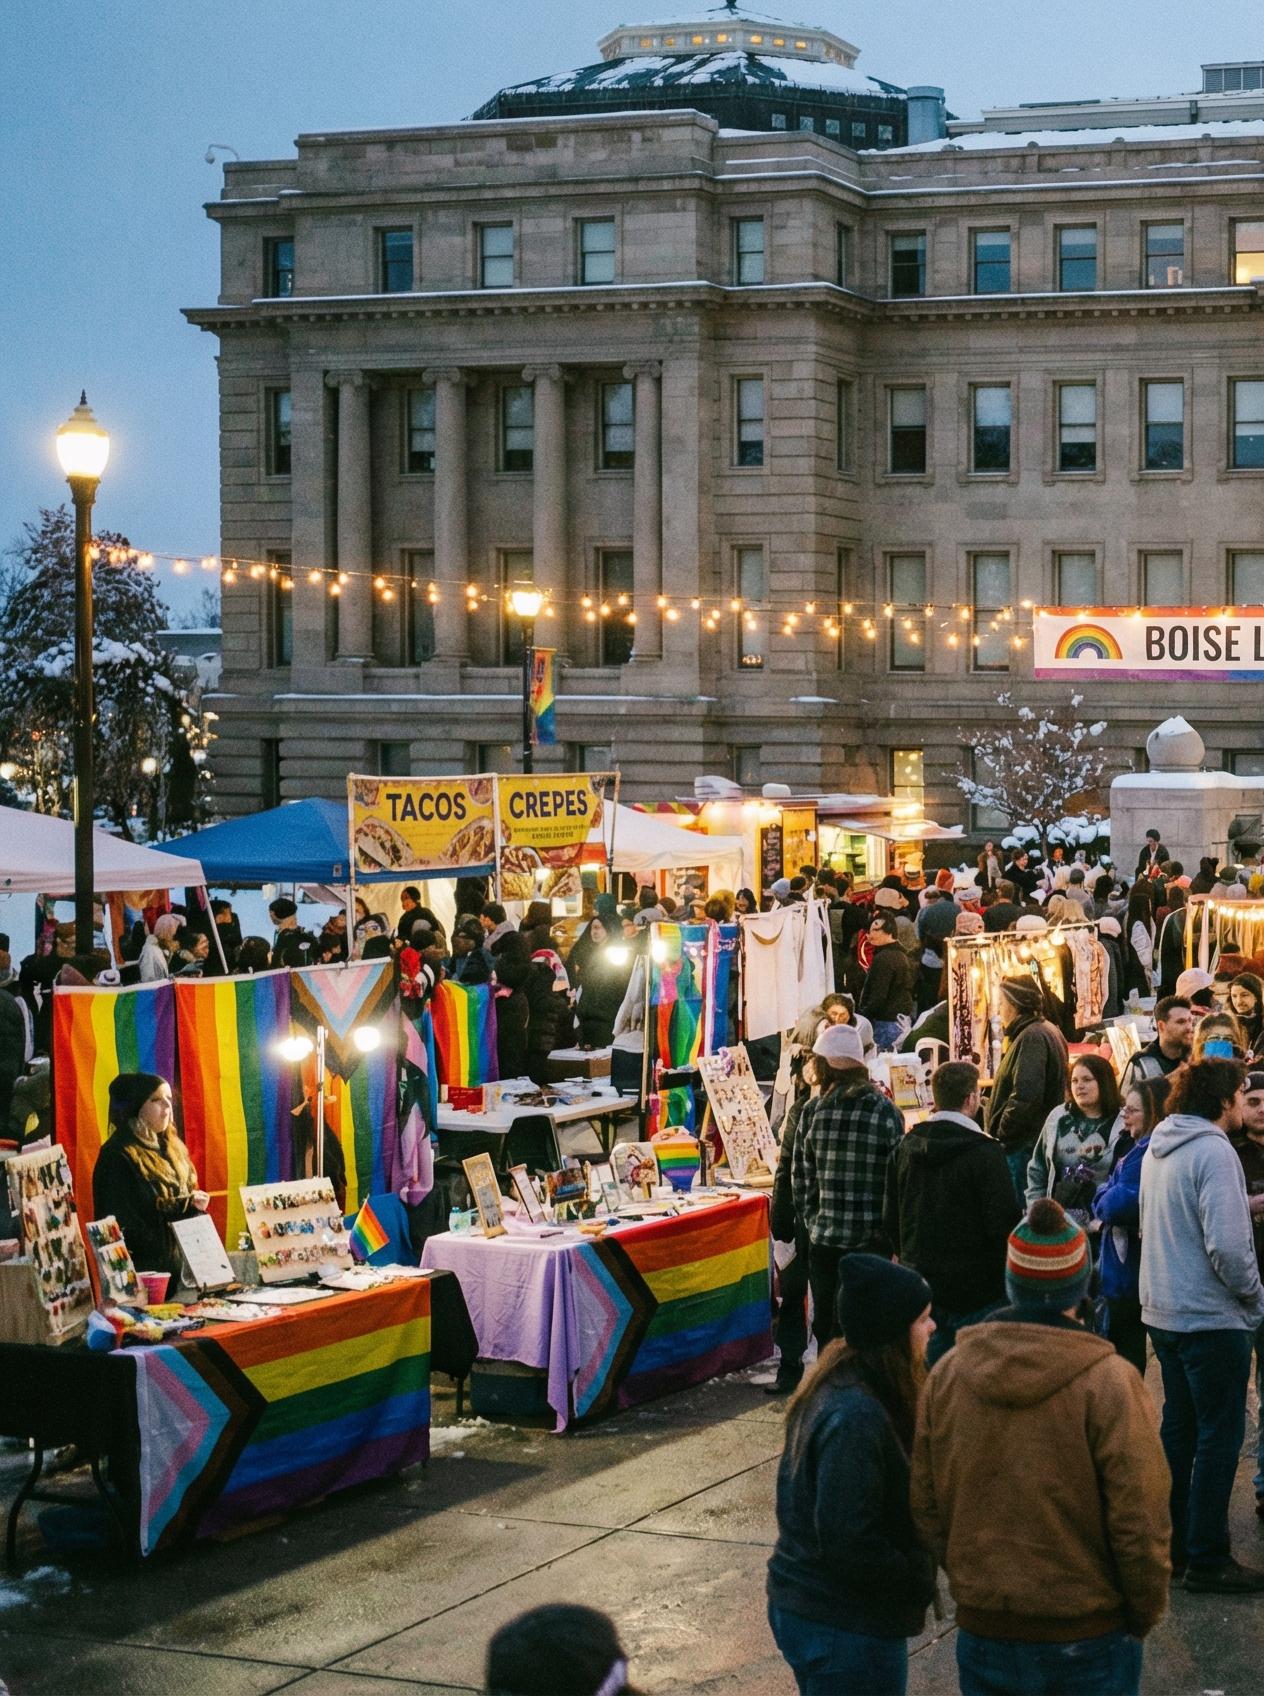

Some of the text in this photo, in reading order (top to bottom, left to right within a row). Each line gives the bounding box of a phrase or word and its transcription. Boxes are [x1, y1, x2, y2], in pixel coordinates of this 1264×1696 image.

[1145, 625, 1241, 662] BOISE
[386, 792, 467, 822] TACOS
[509, 789, 588, 819] CREPES
